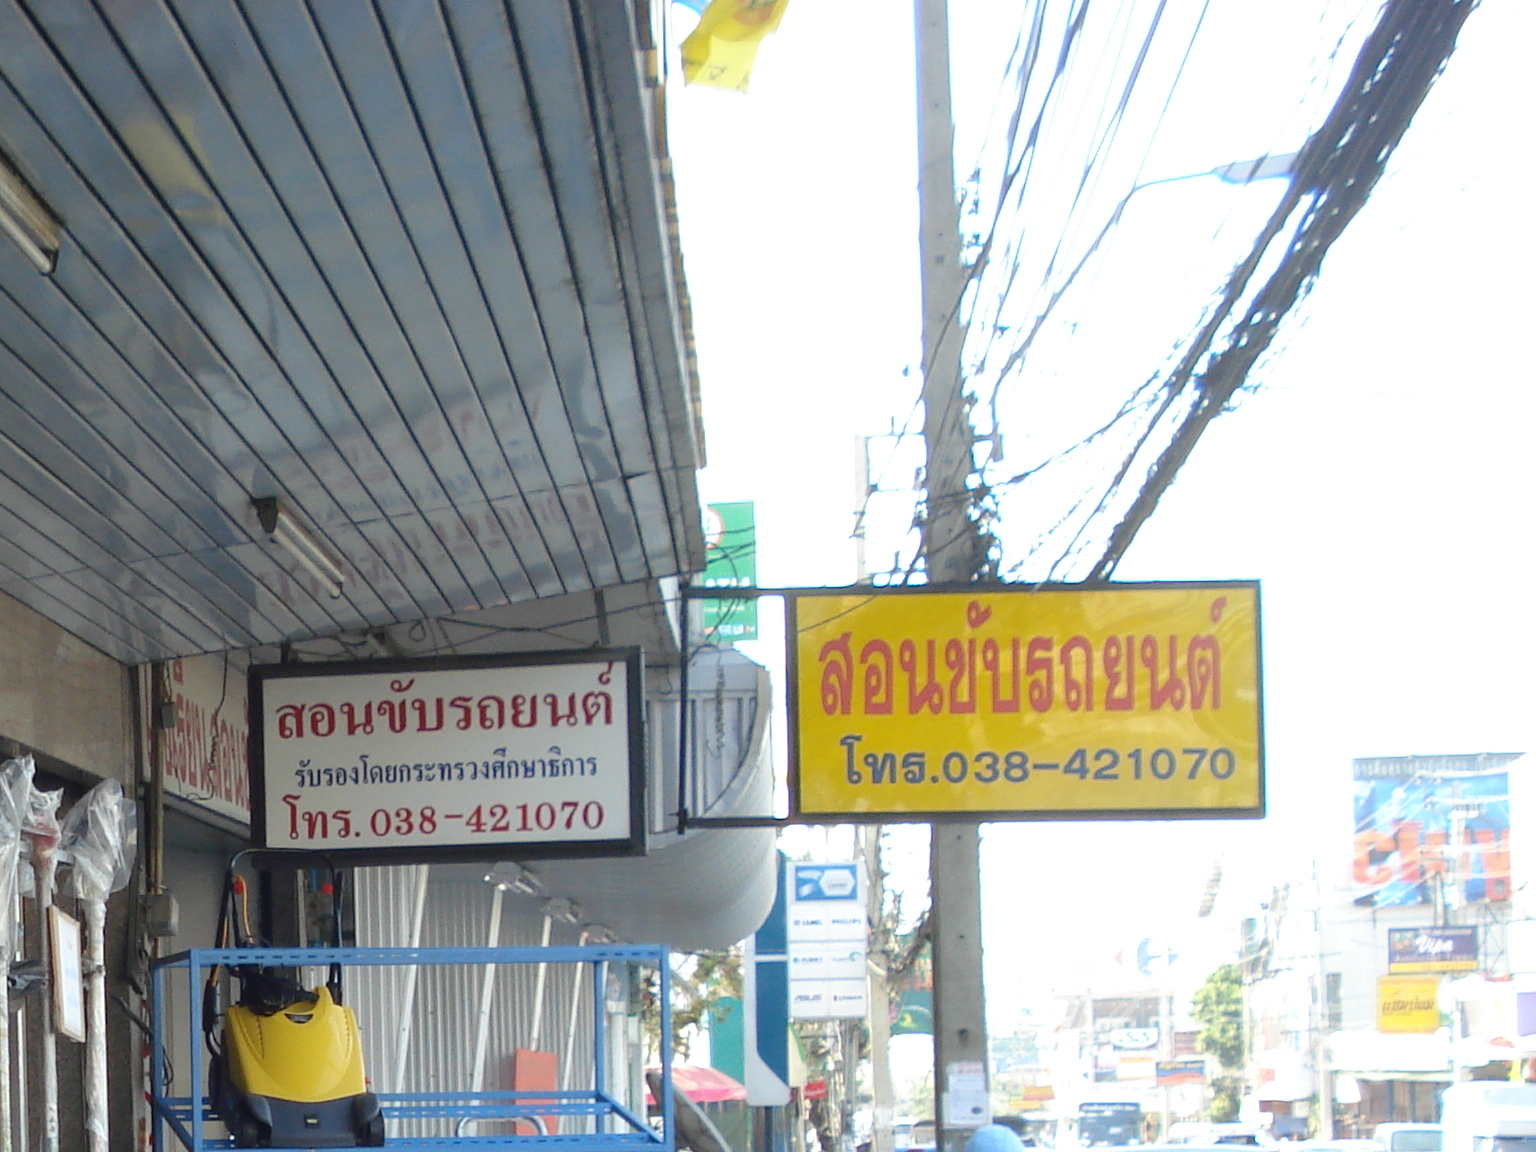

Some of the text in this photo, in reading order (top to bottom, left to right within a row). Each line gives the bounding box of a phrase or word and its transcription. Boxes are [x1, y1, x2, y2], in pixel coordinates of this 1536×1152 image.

[818, 597, 1228, 716] สอนขับรถยนต์
[276, 661, 615, 740] สอนขับรถยนต์
[293, 747, 598, 788] รับรองโดยกระทรวงศึกษาธิการ
